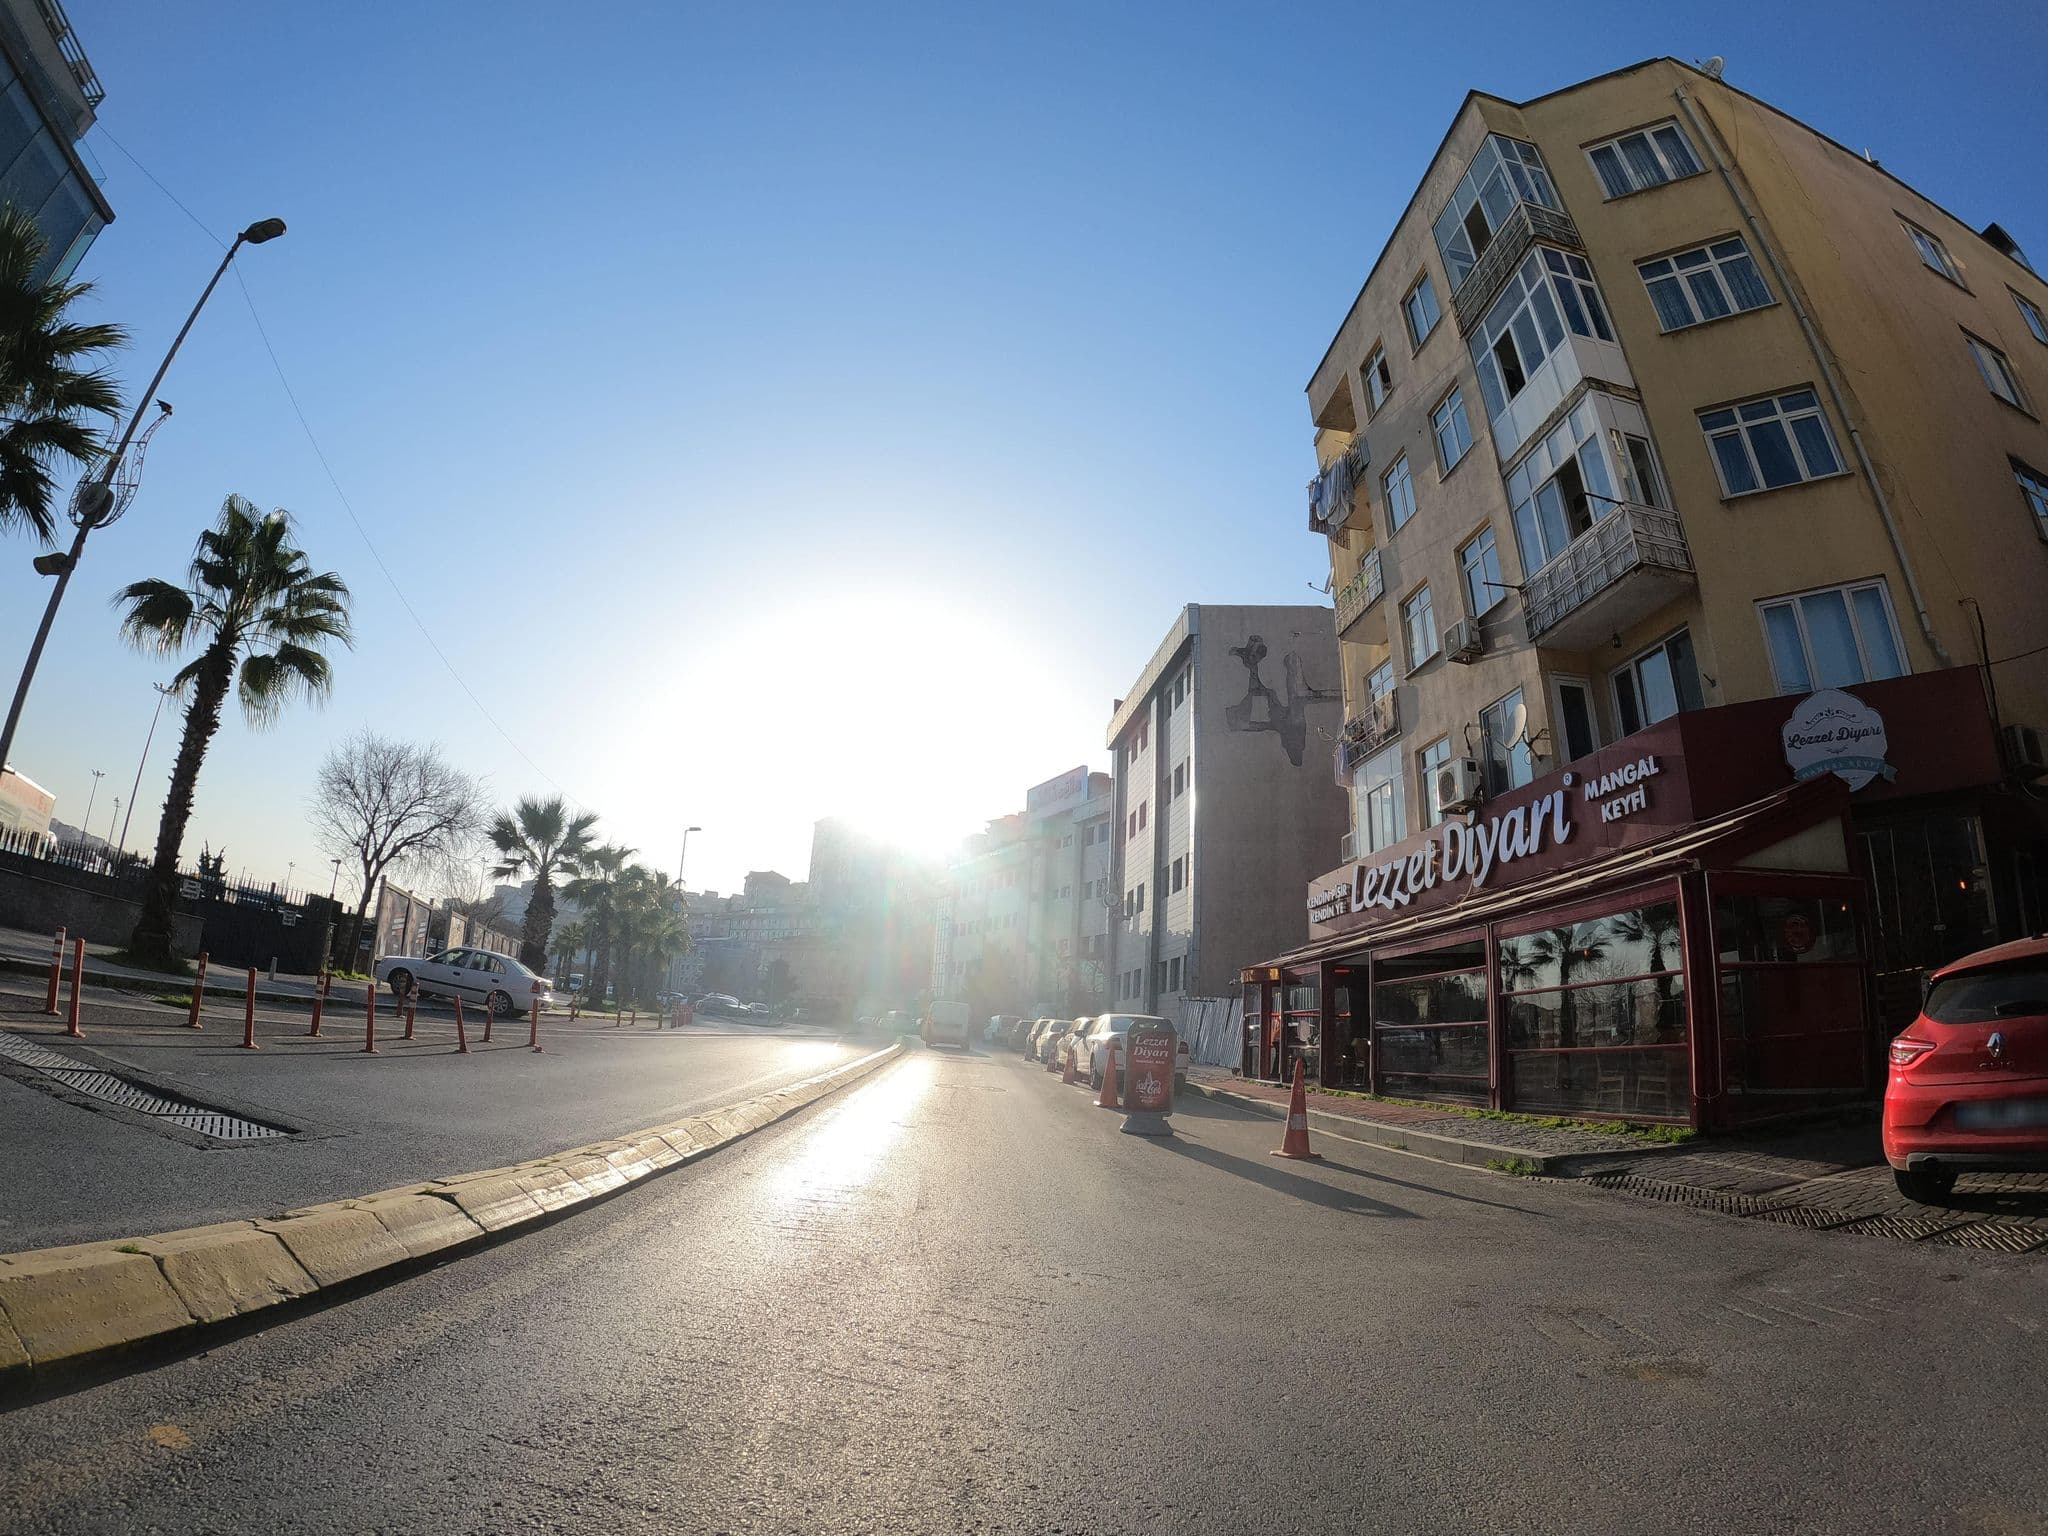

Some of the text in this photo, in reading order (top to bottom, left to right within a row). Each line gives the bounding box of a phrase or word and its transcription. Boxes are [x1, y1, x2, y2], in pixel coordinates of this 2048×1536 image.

[1787, 731, 1834, 750] Lezzet
[1584, 755, 1659, 802] MANGAL
[1601, 784, 1646, 823] KEYFİ
[1351, 839, 1437, 913] Lezzet
[1442, 790, 1571, 888] Diyarı
